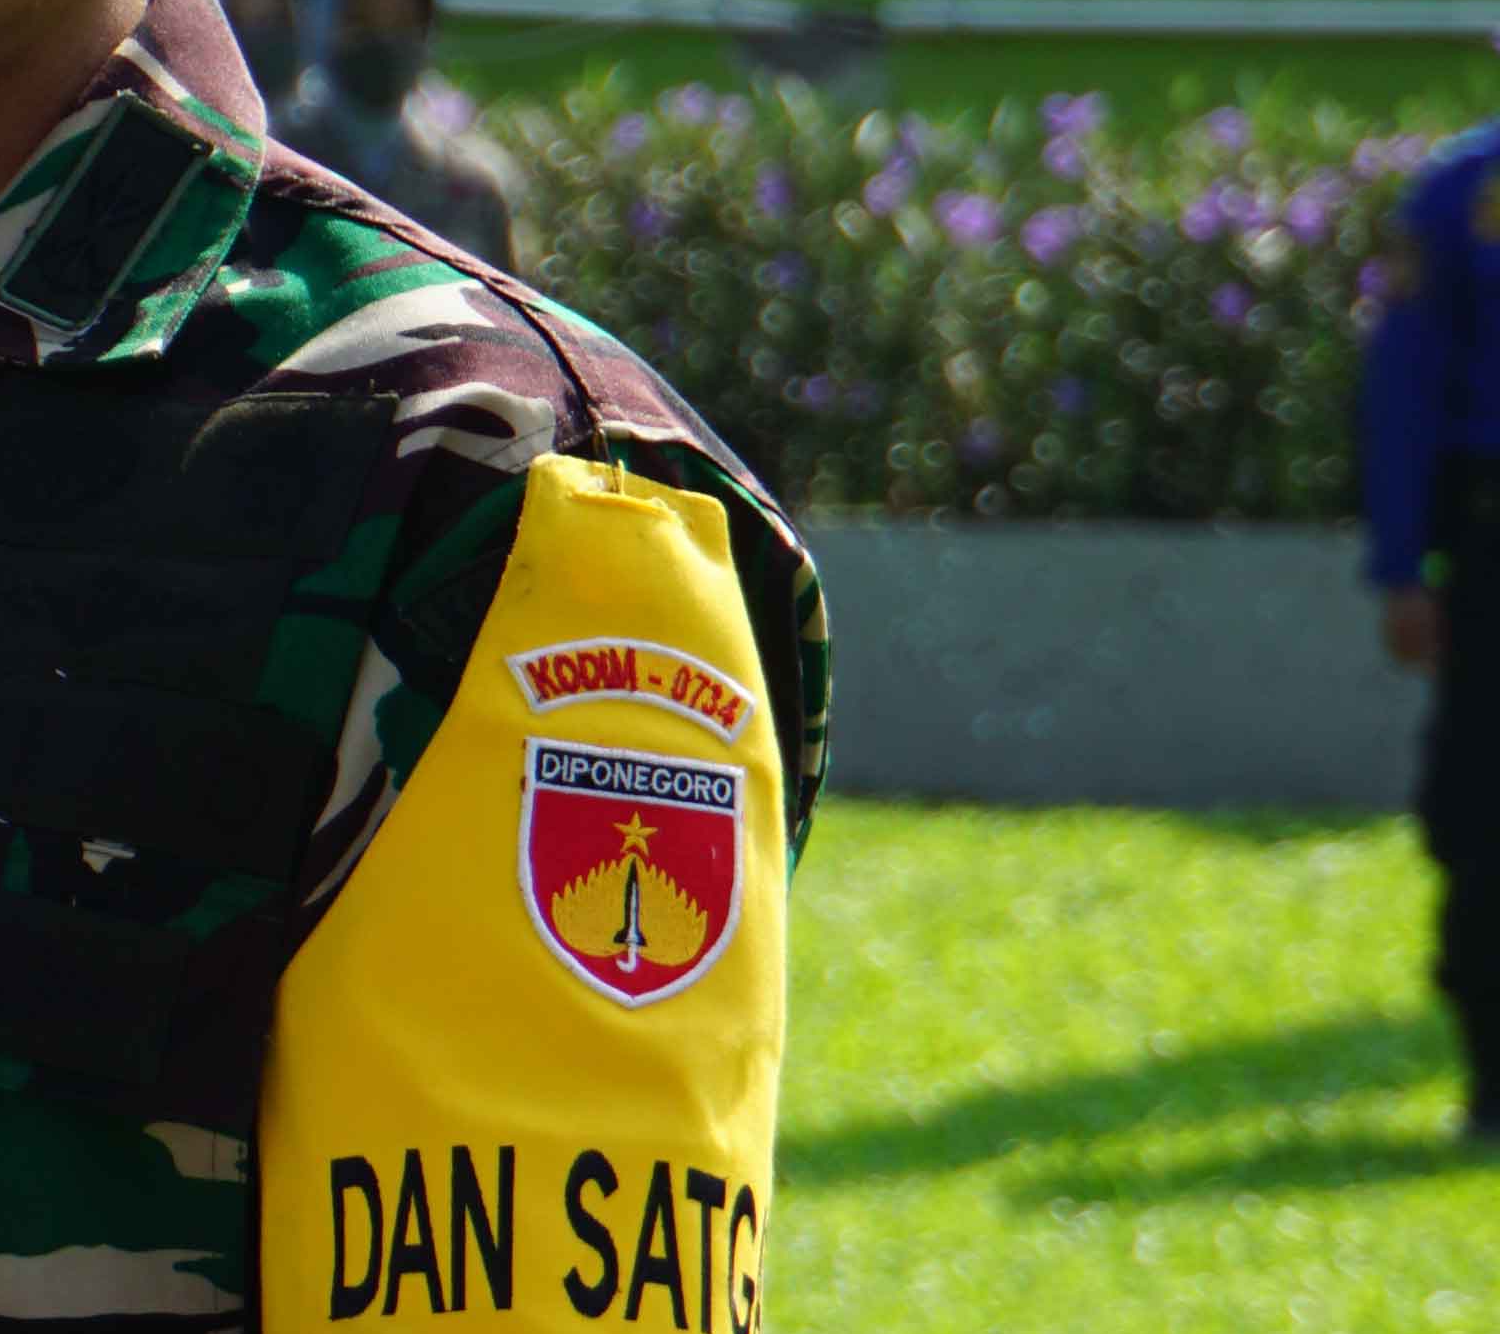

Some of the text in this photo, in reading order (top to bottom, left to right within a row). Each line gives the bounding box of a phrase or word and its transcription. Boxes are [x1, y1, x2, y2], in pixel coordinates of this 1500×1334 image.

[526, 646, 638, 700] KODIM
[671, 663, 741, 727] 0734
[540, 752, 732, 804] DIPONEGORO
[329, 1145, 515, 1321] DAN
